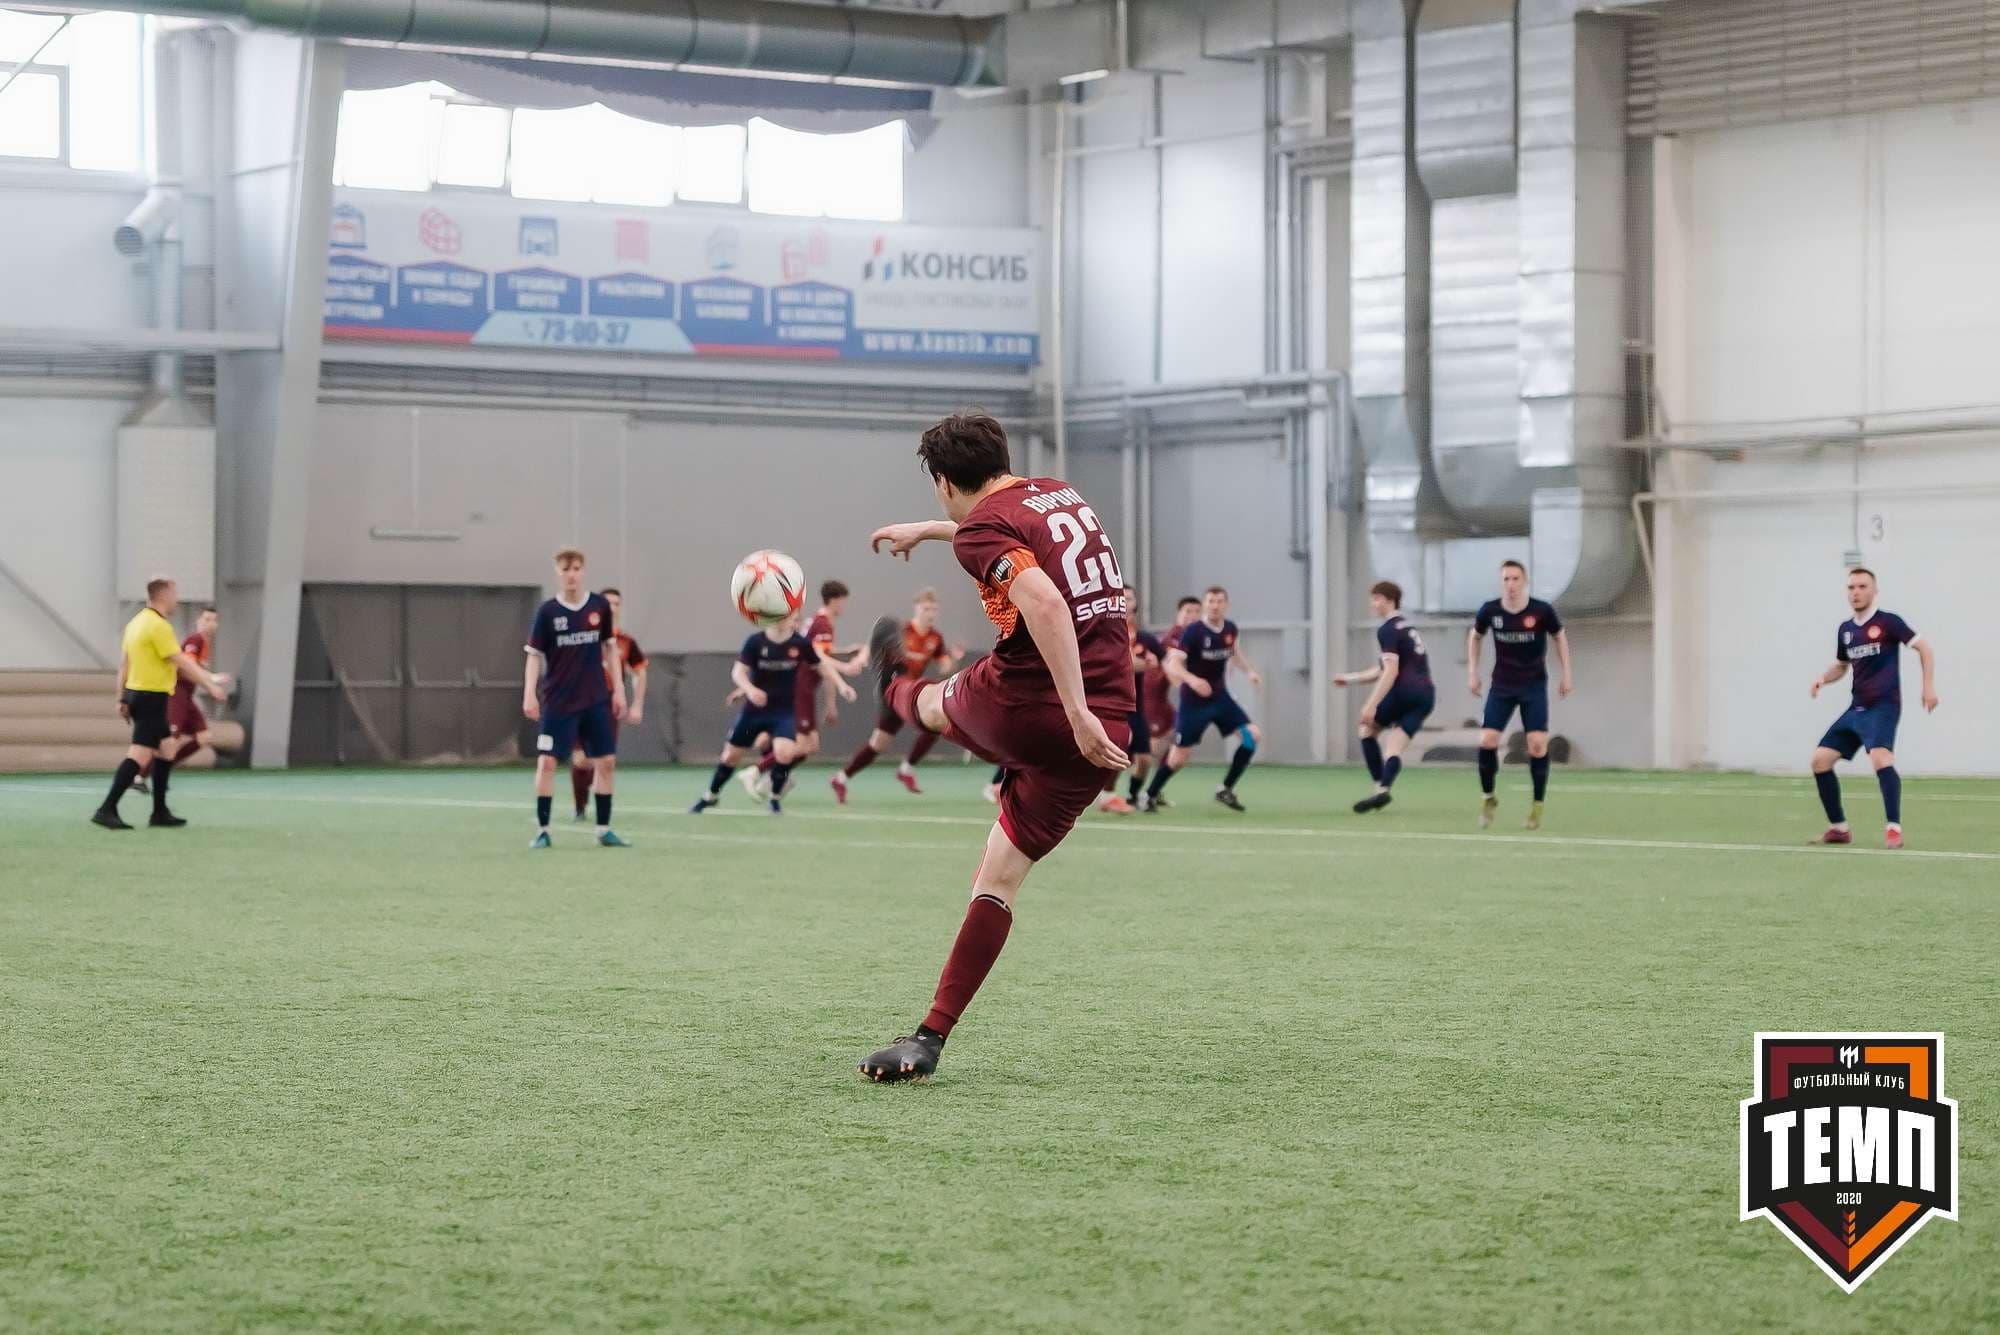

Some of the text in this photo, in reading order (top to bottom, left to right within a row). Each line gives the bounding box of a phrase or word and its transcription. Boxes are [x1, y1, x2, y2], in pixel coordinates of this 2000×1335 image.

[902, 252, 1029, 283] КОНСИБ
[1870, 513, 1885, 542] 3
[1047, 506, 1124, 598] 23
